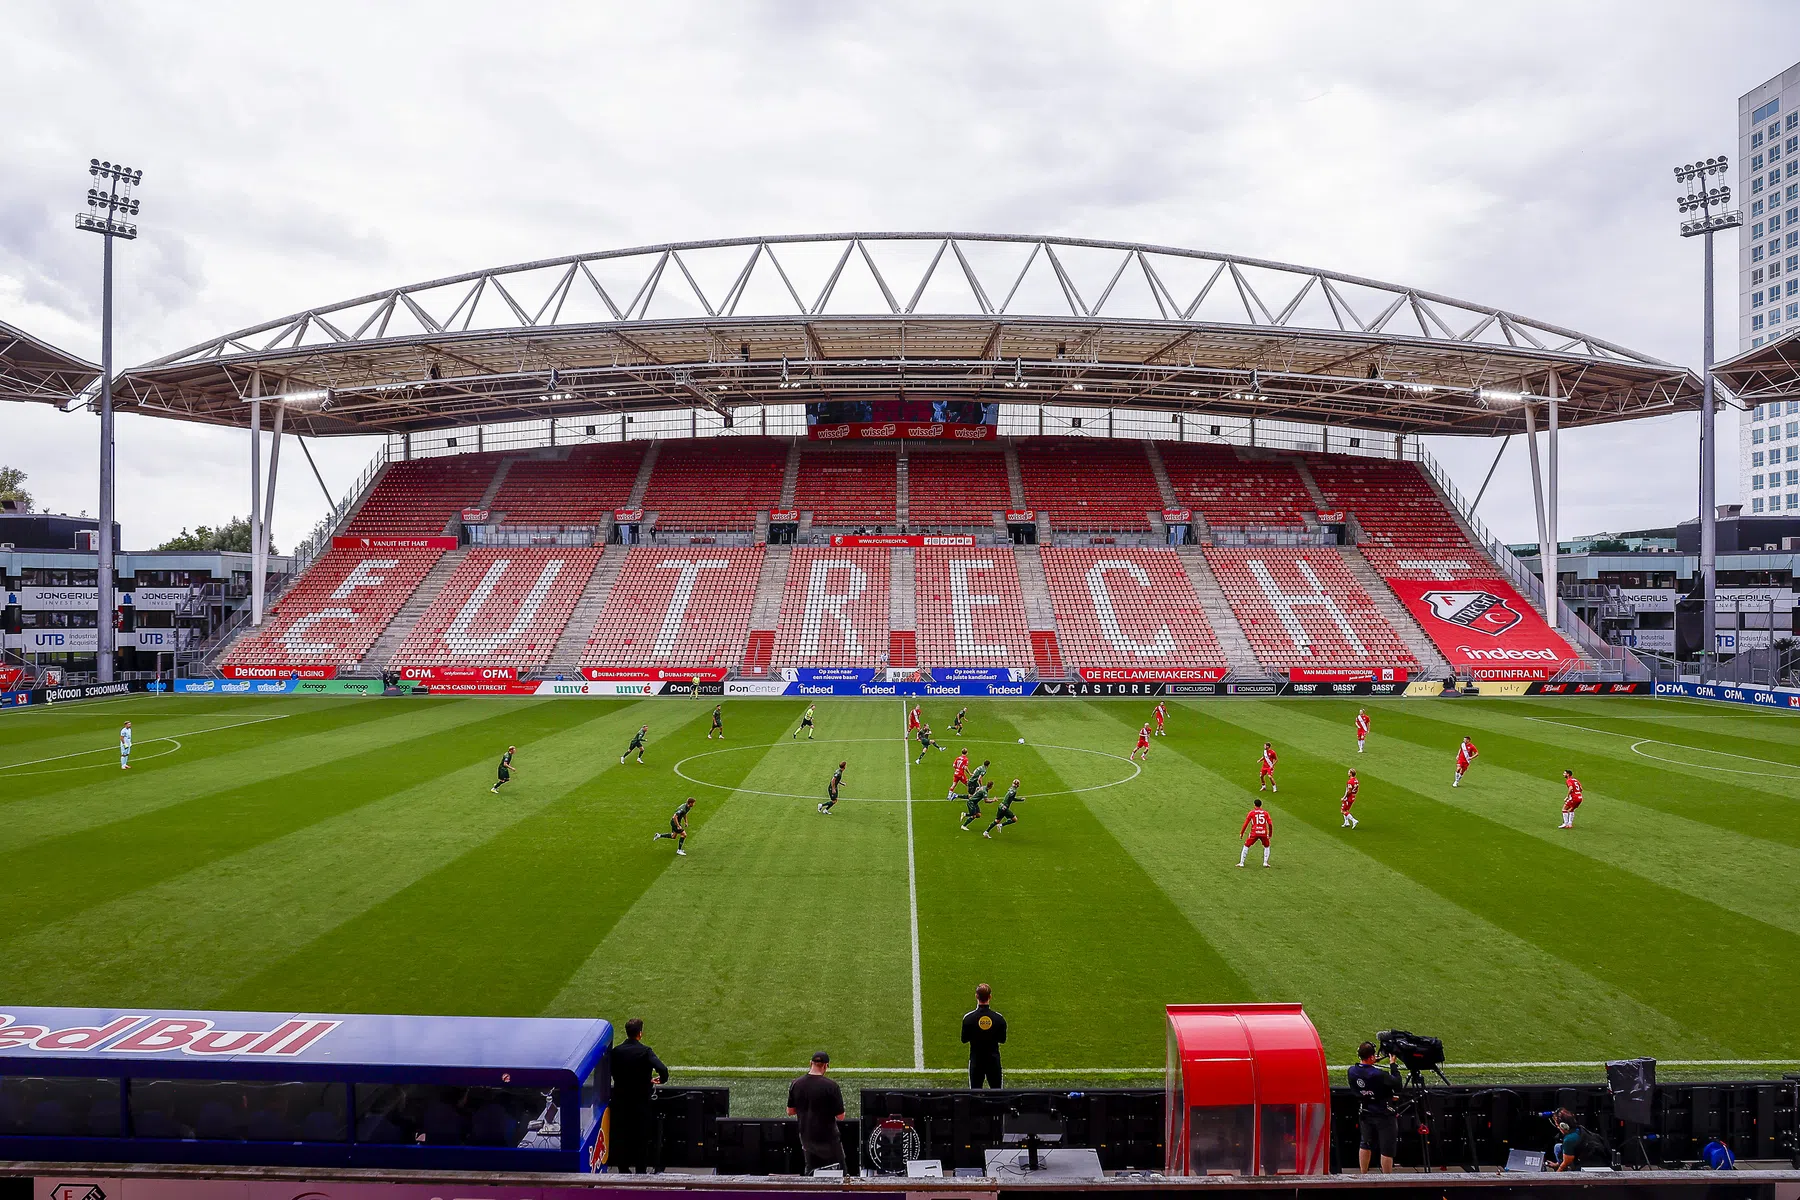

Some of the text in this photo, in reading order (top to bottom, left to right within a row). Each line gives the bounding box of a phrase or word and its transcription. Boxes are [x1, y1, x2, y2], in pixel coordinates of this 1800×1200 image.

[36, 633, 65, 646] UTB
[140, 633, 163, 645] UTB
[1457, 646, 1559, 661] indeed
[234, 667, 277, 677] DeKroon
[405, 668, 435, 678] OFM.
[482, 669, 512, 679] OFM.
[1086, 669, 1219, 679] DE RECLAMEMAKERS.NL
[1472, 669, 1546, 680] KOOTINFRA.NL
[46, 686, 82, 701] DeKroon
[85, 682, 130, 697] SCHOONMAAK
[553, 682, 589, 694] univé
[616, 682, 651, 694] univé
[729, 684, 780, 694] PonCenter
[799, 684, 834, 694] indeed
[860, 684, 896, 694] indeed
[924, 684, 960, 694] indeed
[986, 684, 1022, 694] indeed
[1068, 684, 1151, 694] CASTORE
[1656, 684, 1688, 695] OFM.
[1696, 686, 1716, 697] OFM.
[1724, 689, 1745, 701] OFM.
[1754, 692, 1777, 704] OFM.
[1254, 813, 1266, 825] 15
[104, 1017, 340, 1055] Bull
